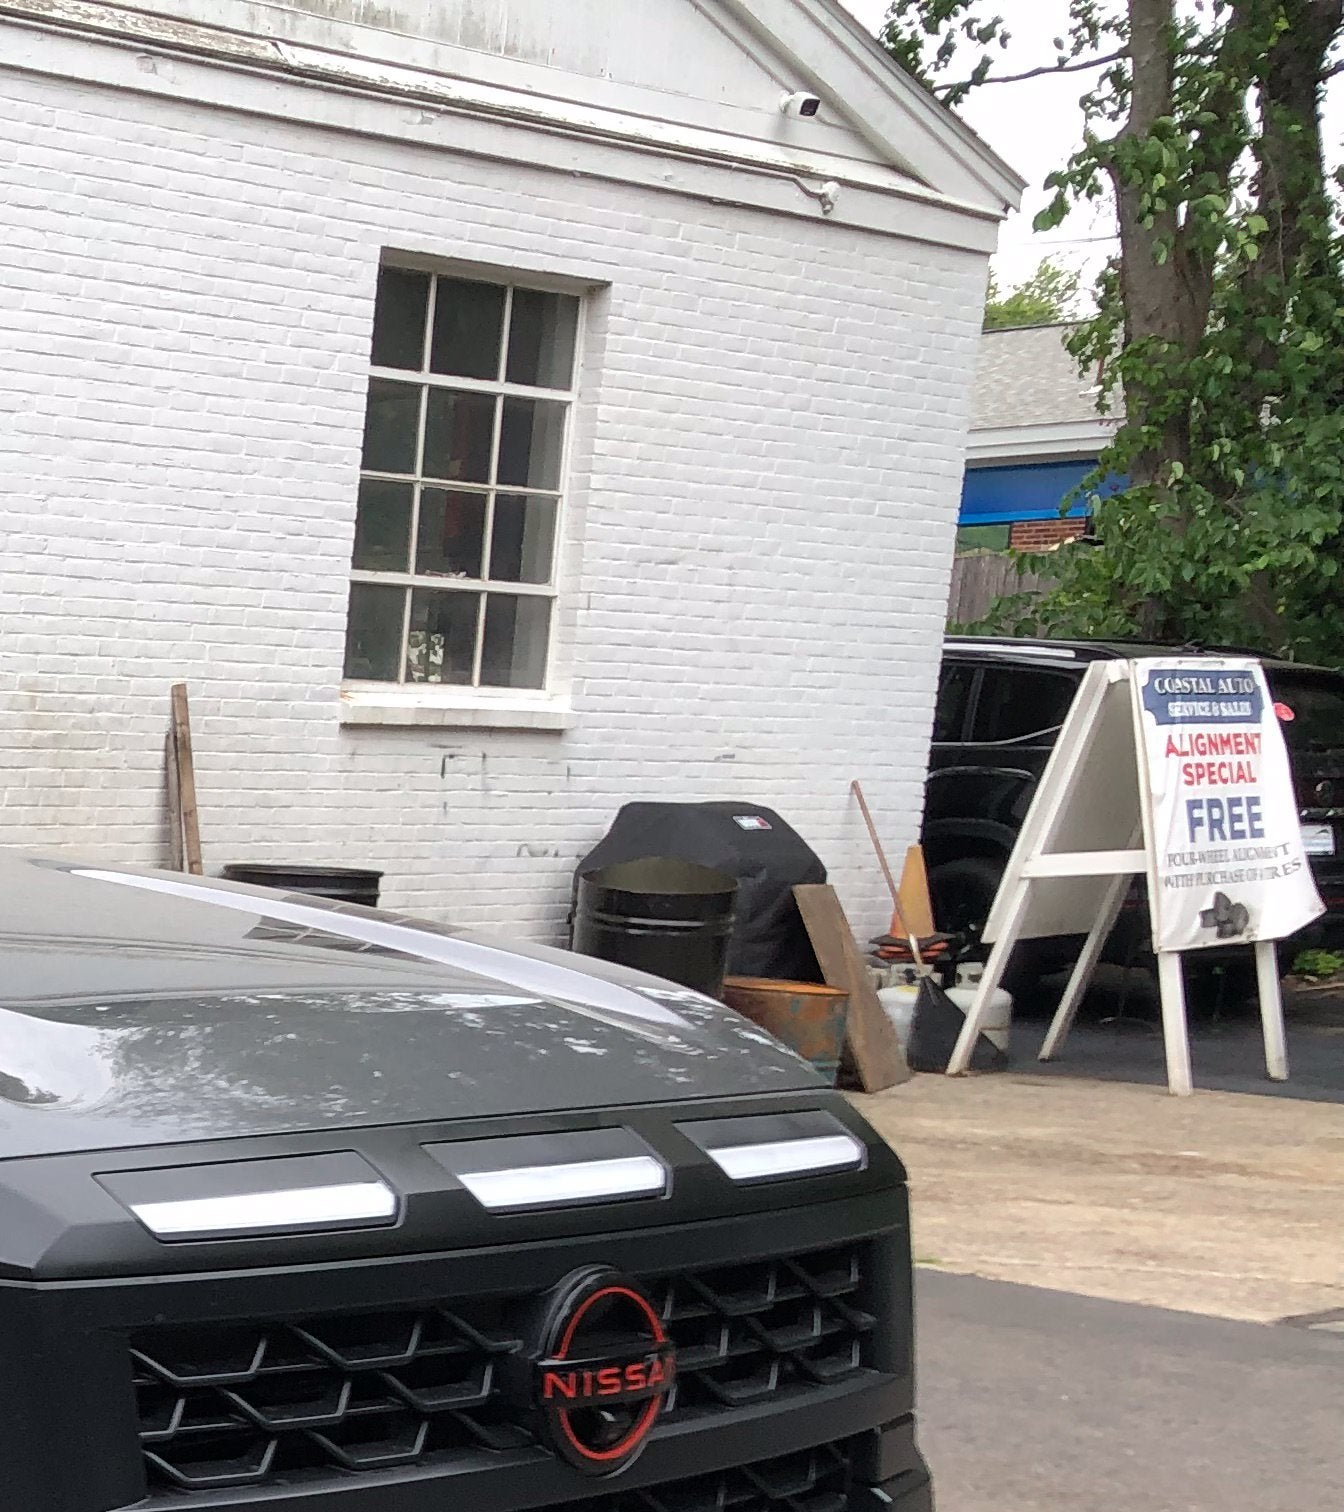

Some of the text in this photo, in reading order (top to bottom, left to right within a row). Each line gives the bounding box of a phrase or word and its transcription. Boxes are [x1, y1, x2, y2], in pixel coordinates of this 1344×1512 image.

[1154, 677, 1255, 695] COASTAL AUTO
[1165, 732, 1262, 759] ALIGNMENT
[1182, 762, 1257, 786] SPECIAL
[1186, 796, 1265, 843] FREE
